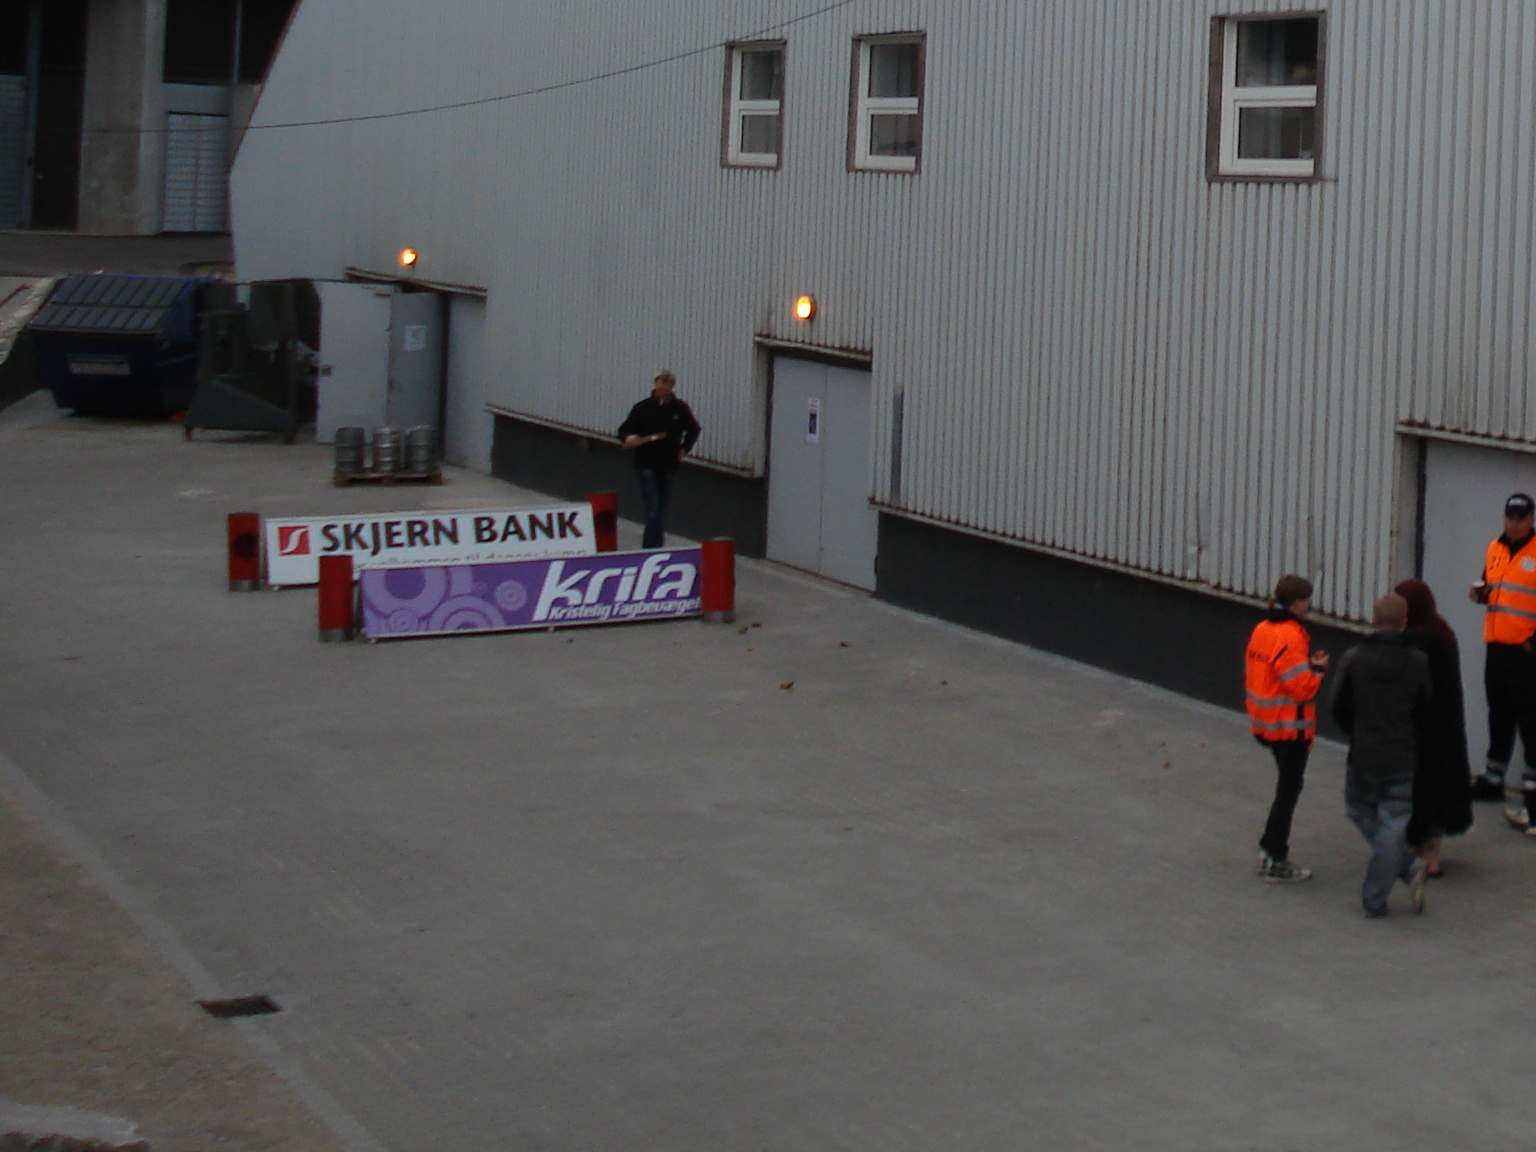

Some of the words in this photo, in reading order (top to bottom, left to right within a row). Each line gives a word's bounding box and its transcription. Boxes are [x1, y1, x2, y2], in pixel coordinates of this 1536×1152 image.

[321, 520, 459, 557] SKJERN
[474, 511, 583, 544] BANK
[532, 553, 697, 621] krifa
[550, 604, 611, 621] Kristelig
